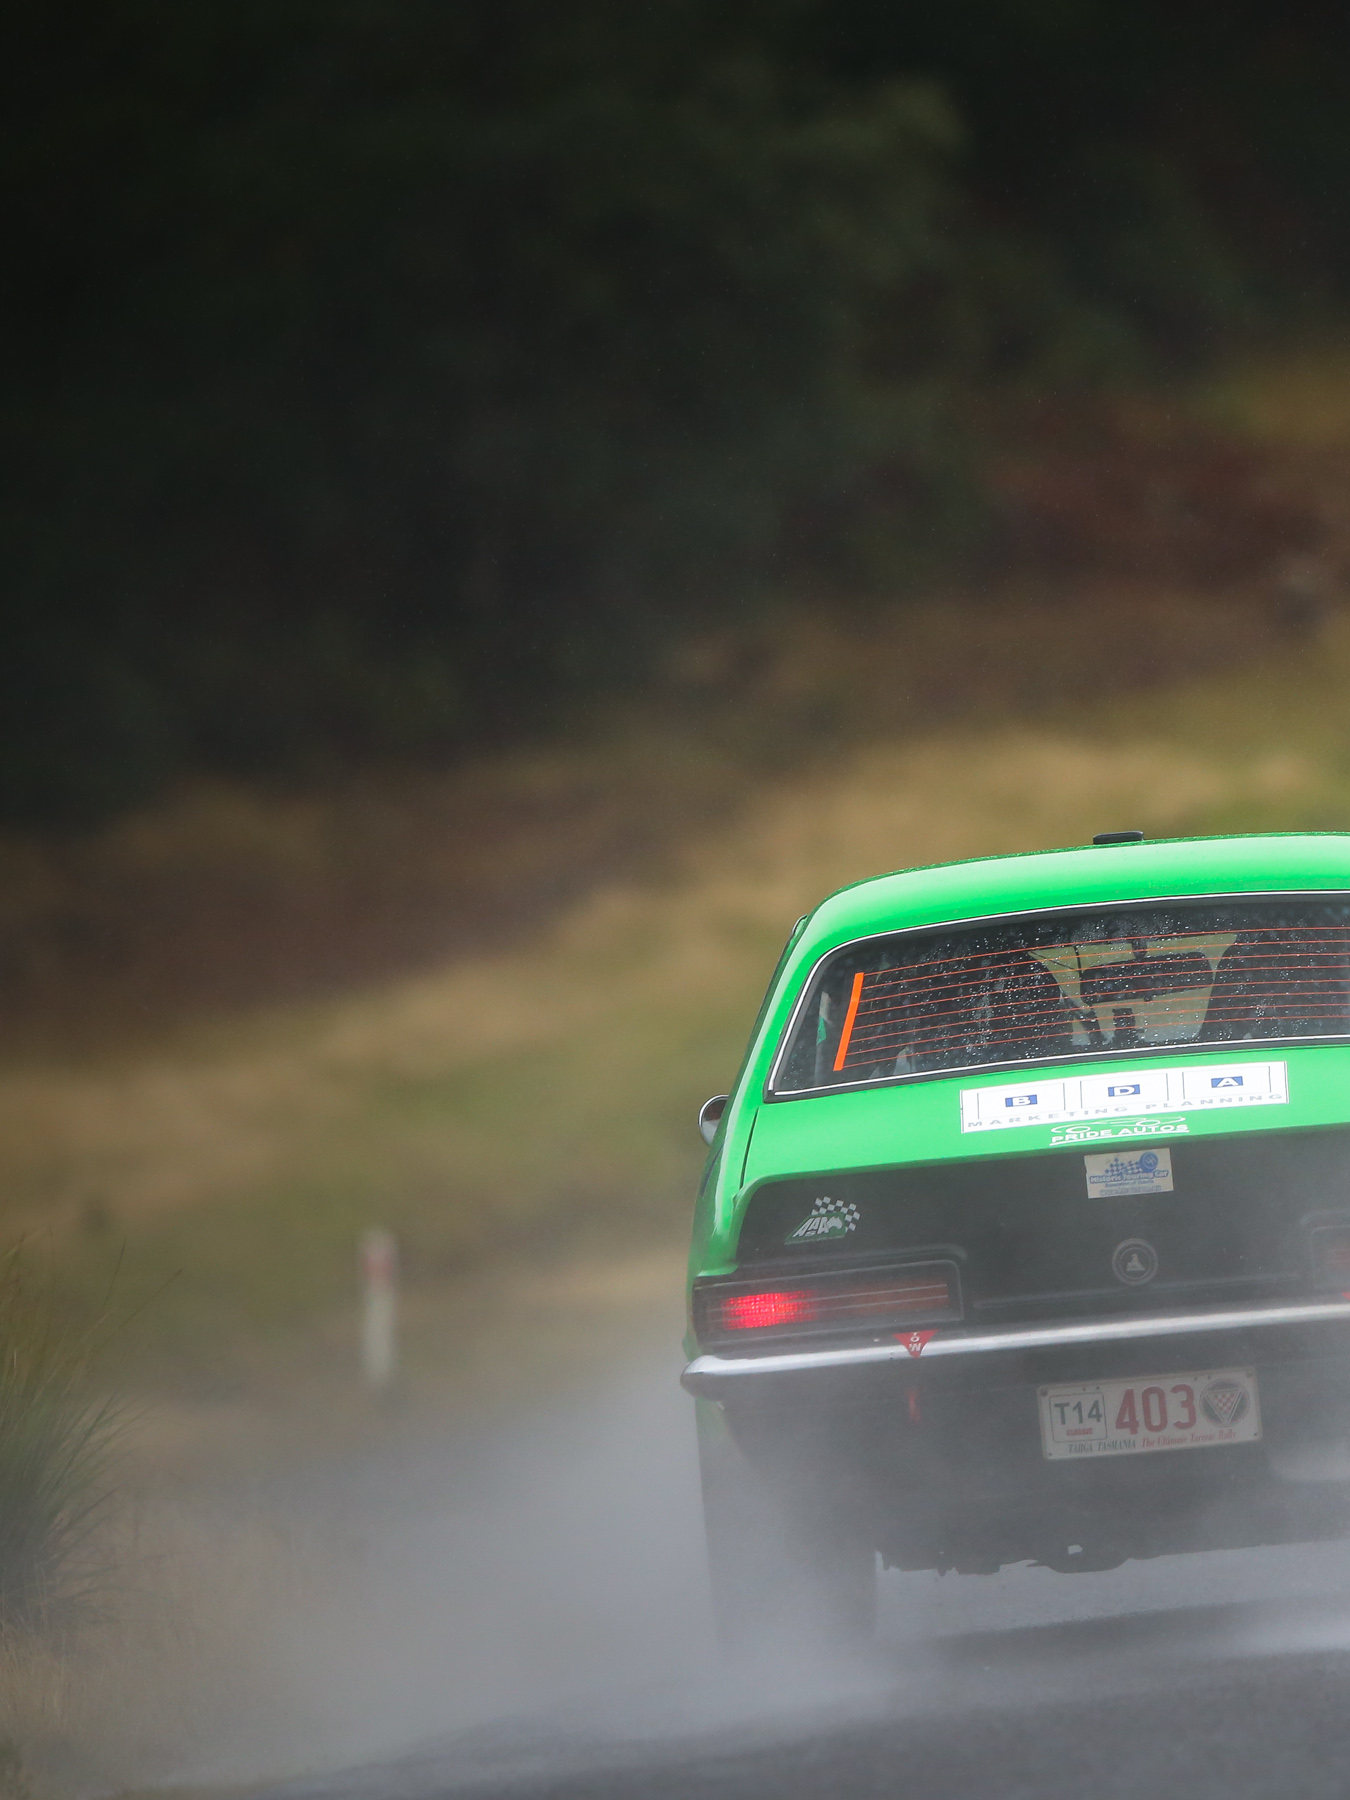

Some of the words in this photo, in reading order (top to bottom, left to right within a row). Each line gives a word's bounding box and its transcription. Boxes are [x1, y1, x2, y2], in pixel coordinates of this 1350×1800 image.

[1011, 1095, 1031, 1106] B
[1113, 1086, 1136, 1096] D
[1216, 1076, 1239, 1087] A
[967, 1106, 1128, 1128] MARKETING
[1145, 1093, 1282, 1110] PLANNING
[1051, 1128, 1113, 1144] PRIDE
[1117, 1124, 1189, 1137] AUTOS
[1053, 1399, 1103, 1426] T14
[1115, 1383, 1197, 1436] 403
[1067, 1443, 1094, 1454] TARGA
[1097, 1439, 1137, 1453] TASMANIA
[1141, 1436, 1155, 1447] The
[1218, 1428, 1237, 1441] Rally
